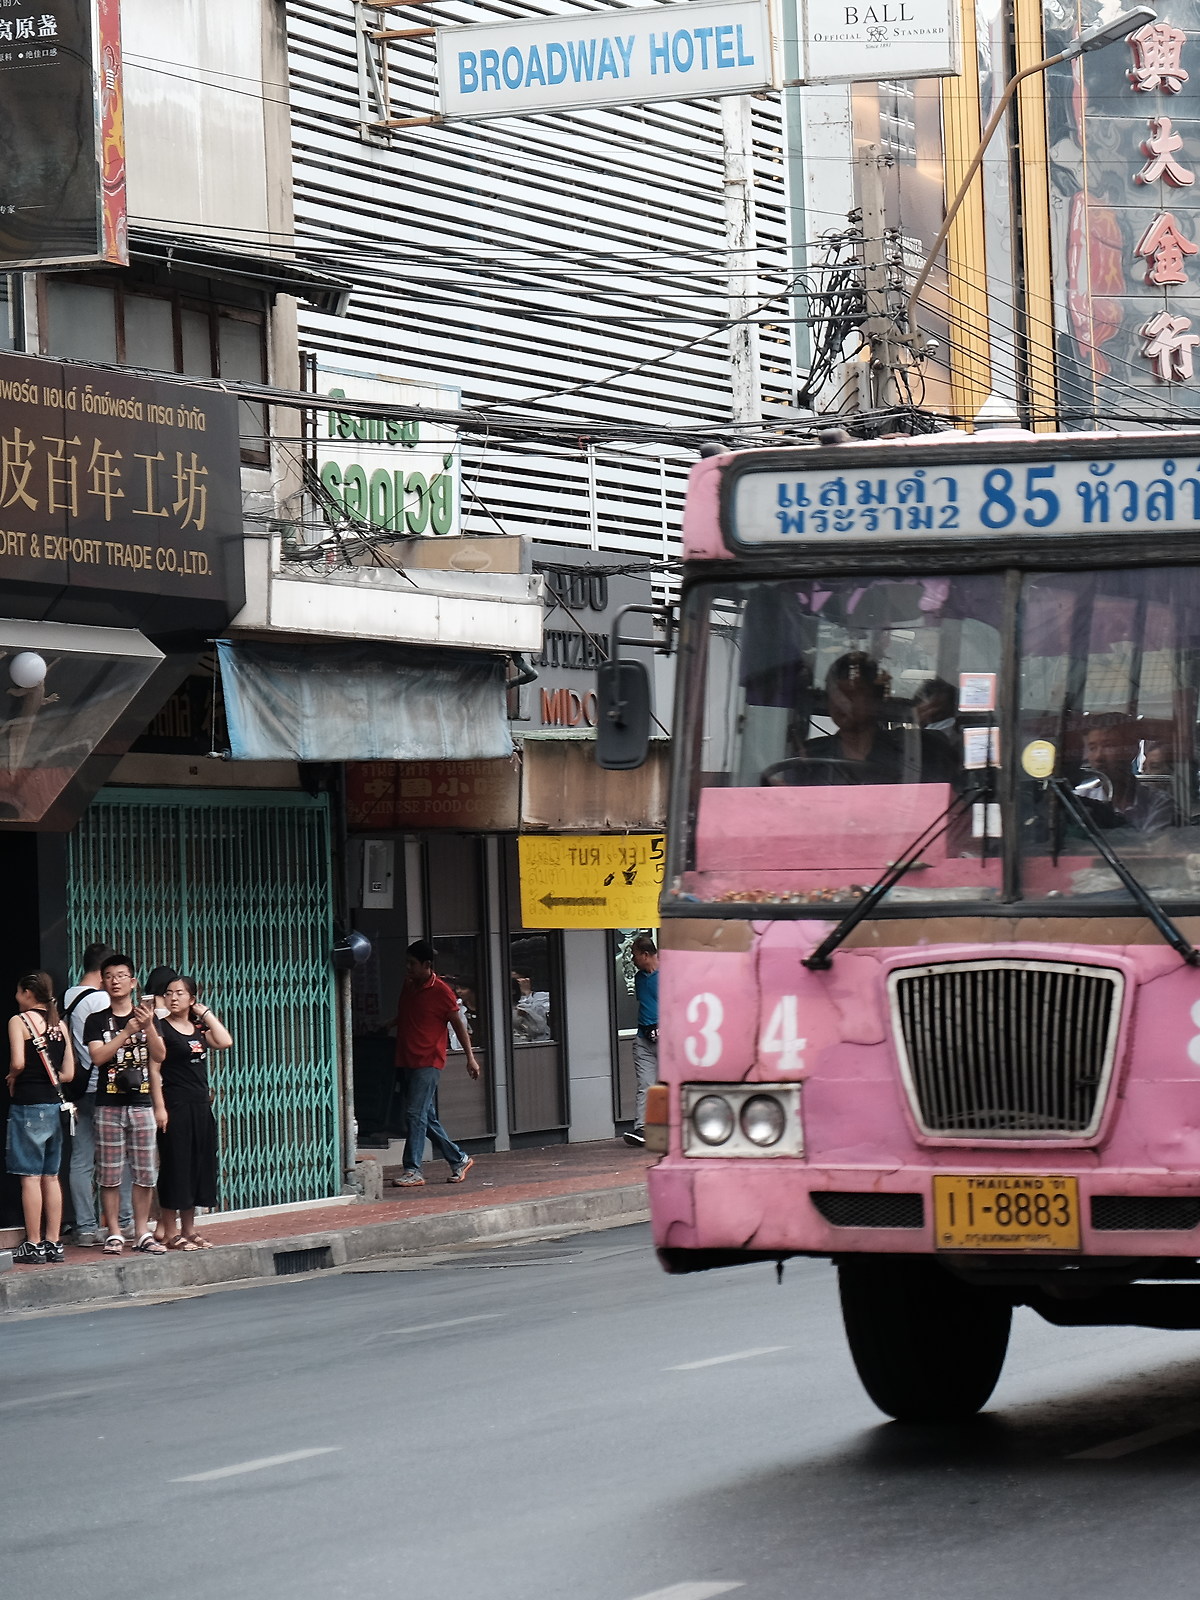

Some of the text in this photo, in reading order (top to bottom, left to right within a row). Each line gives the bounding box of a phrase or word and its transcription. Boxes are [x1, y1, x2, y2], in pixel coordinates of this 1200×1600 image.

[844, 3, 914, 25] BALL
[458, 24, 754, 93] BROADWAY HOTEL
[1126, 22, 1200, 381] 興大金行
[147, 403, 174, 426] เทรด
[177, 403, 206, 432] จำกัด
[778, 469, 958, 508] แสมดำ
[980, 464, 1060, 529] 85
[776, 504, 959, 534] พระราม2
[30, 533, 40, 558] &
[44, 535, 101, 564] EXPORT
[105, 541, 152, 572] TRADE
[531, 628, 609, 670] ITIZEN
[424, 801, 461, 813] FOOD
[967, 1179, 1044, 1189] THAILAND
[949, 1192, 1071, 1227] 11-8883
